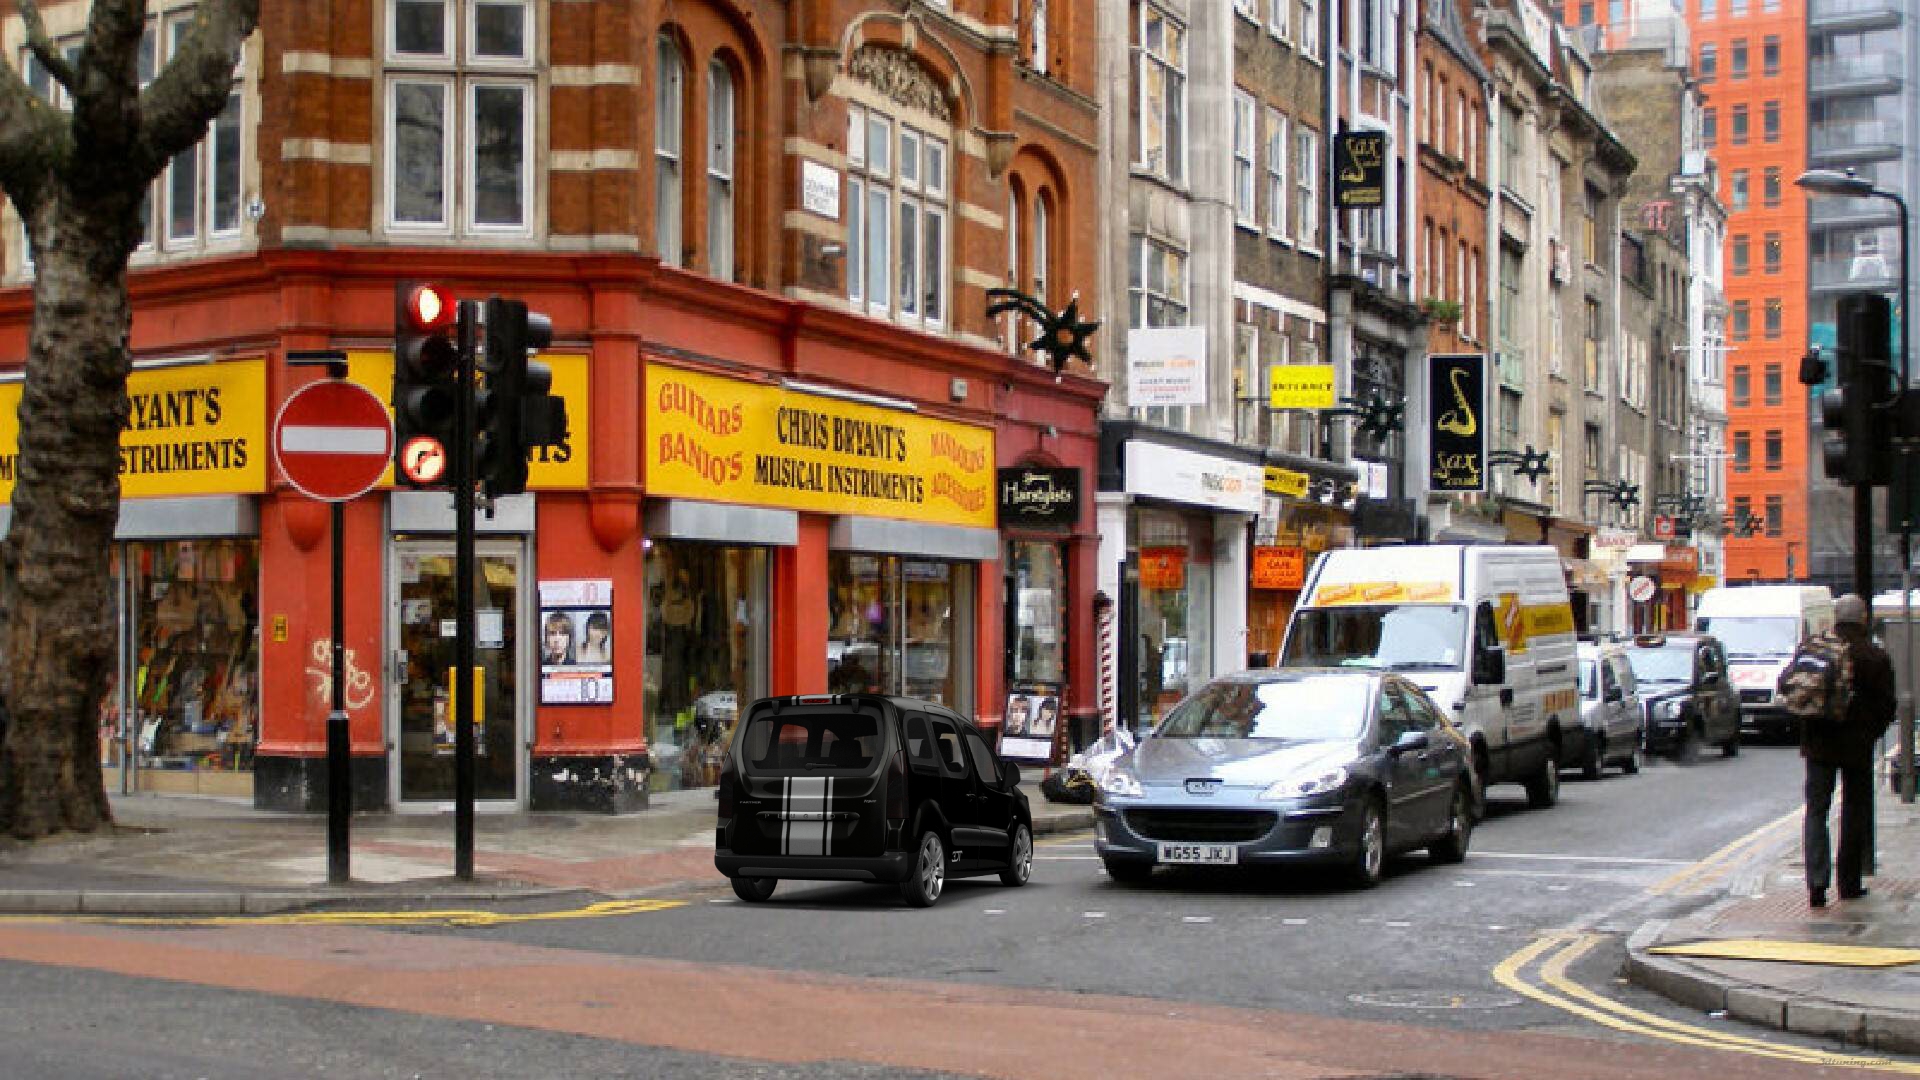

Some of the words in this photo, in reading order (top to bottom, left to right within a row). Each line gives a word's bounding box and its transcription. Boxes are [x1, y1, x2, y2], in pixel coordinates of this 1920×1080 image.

[659, 382, 743, 435] GUITARS
[777, 405, 829, 450] CHRIS
[832, 417, 907, 462] BRYANT'S
[659, 431, 743, 486] BANJO'S
[754, 454, 824, 493] MUSICAL
[827, 465, 924, 503] INSTRUMENTS
[763, 812, 849, 820] PEUGEOT
